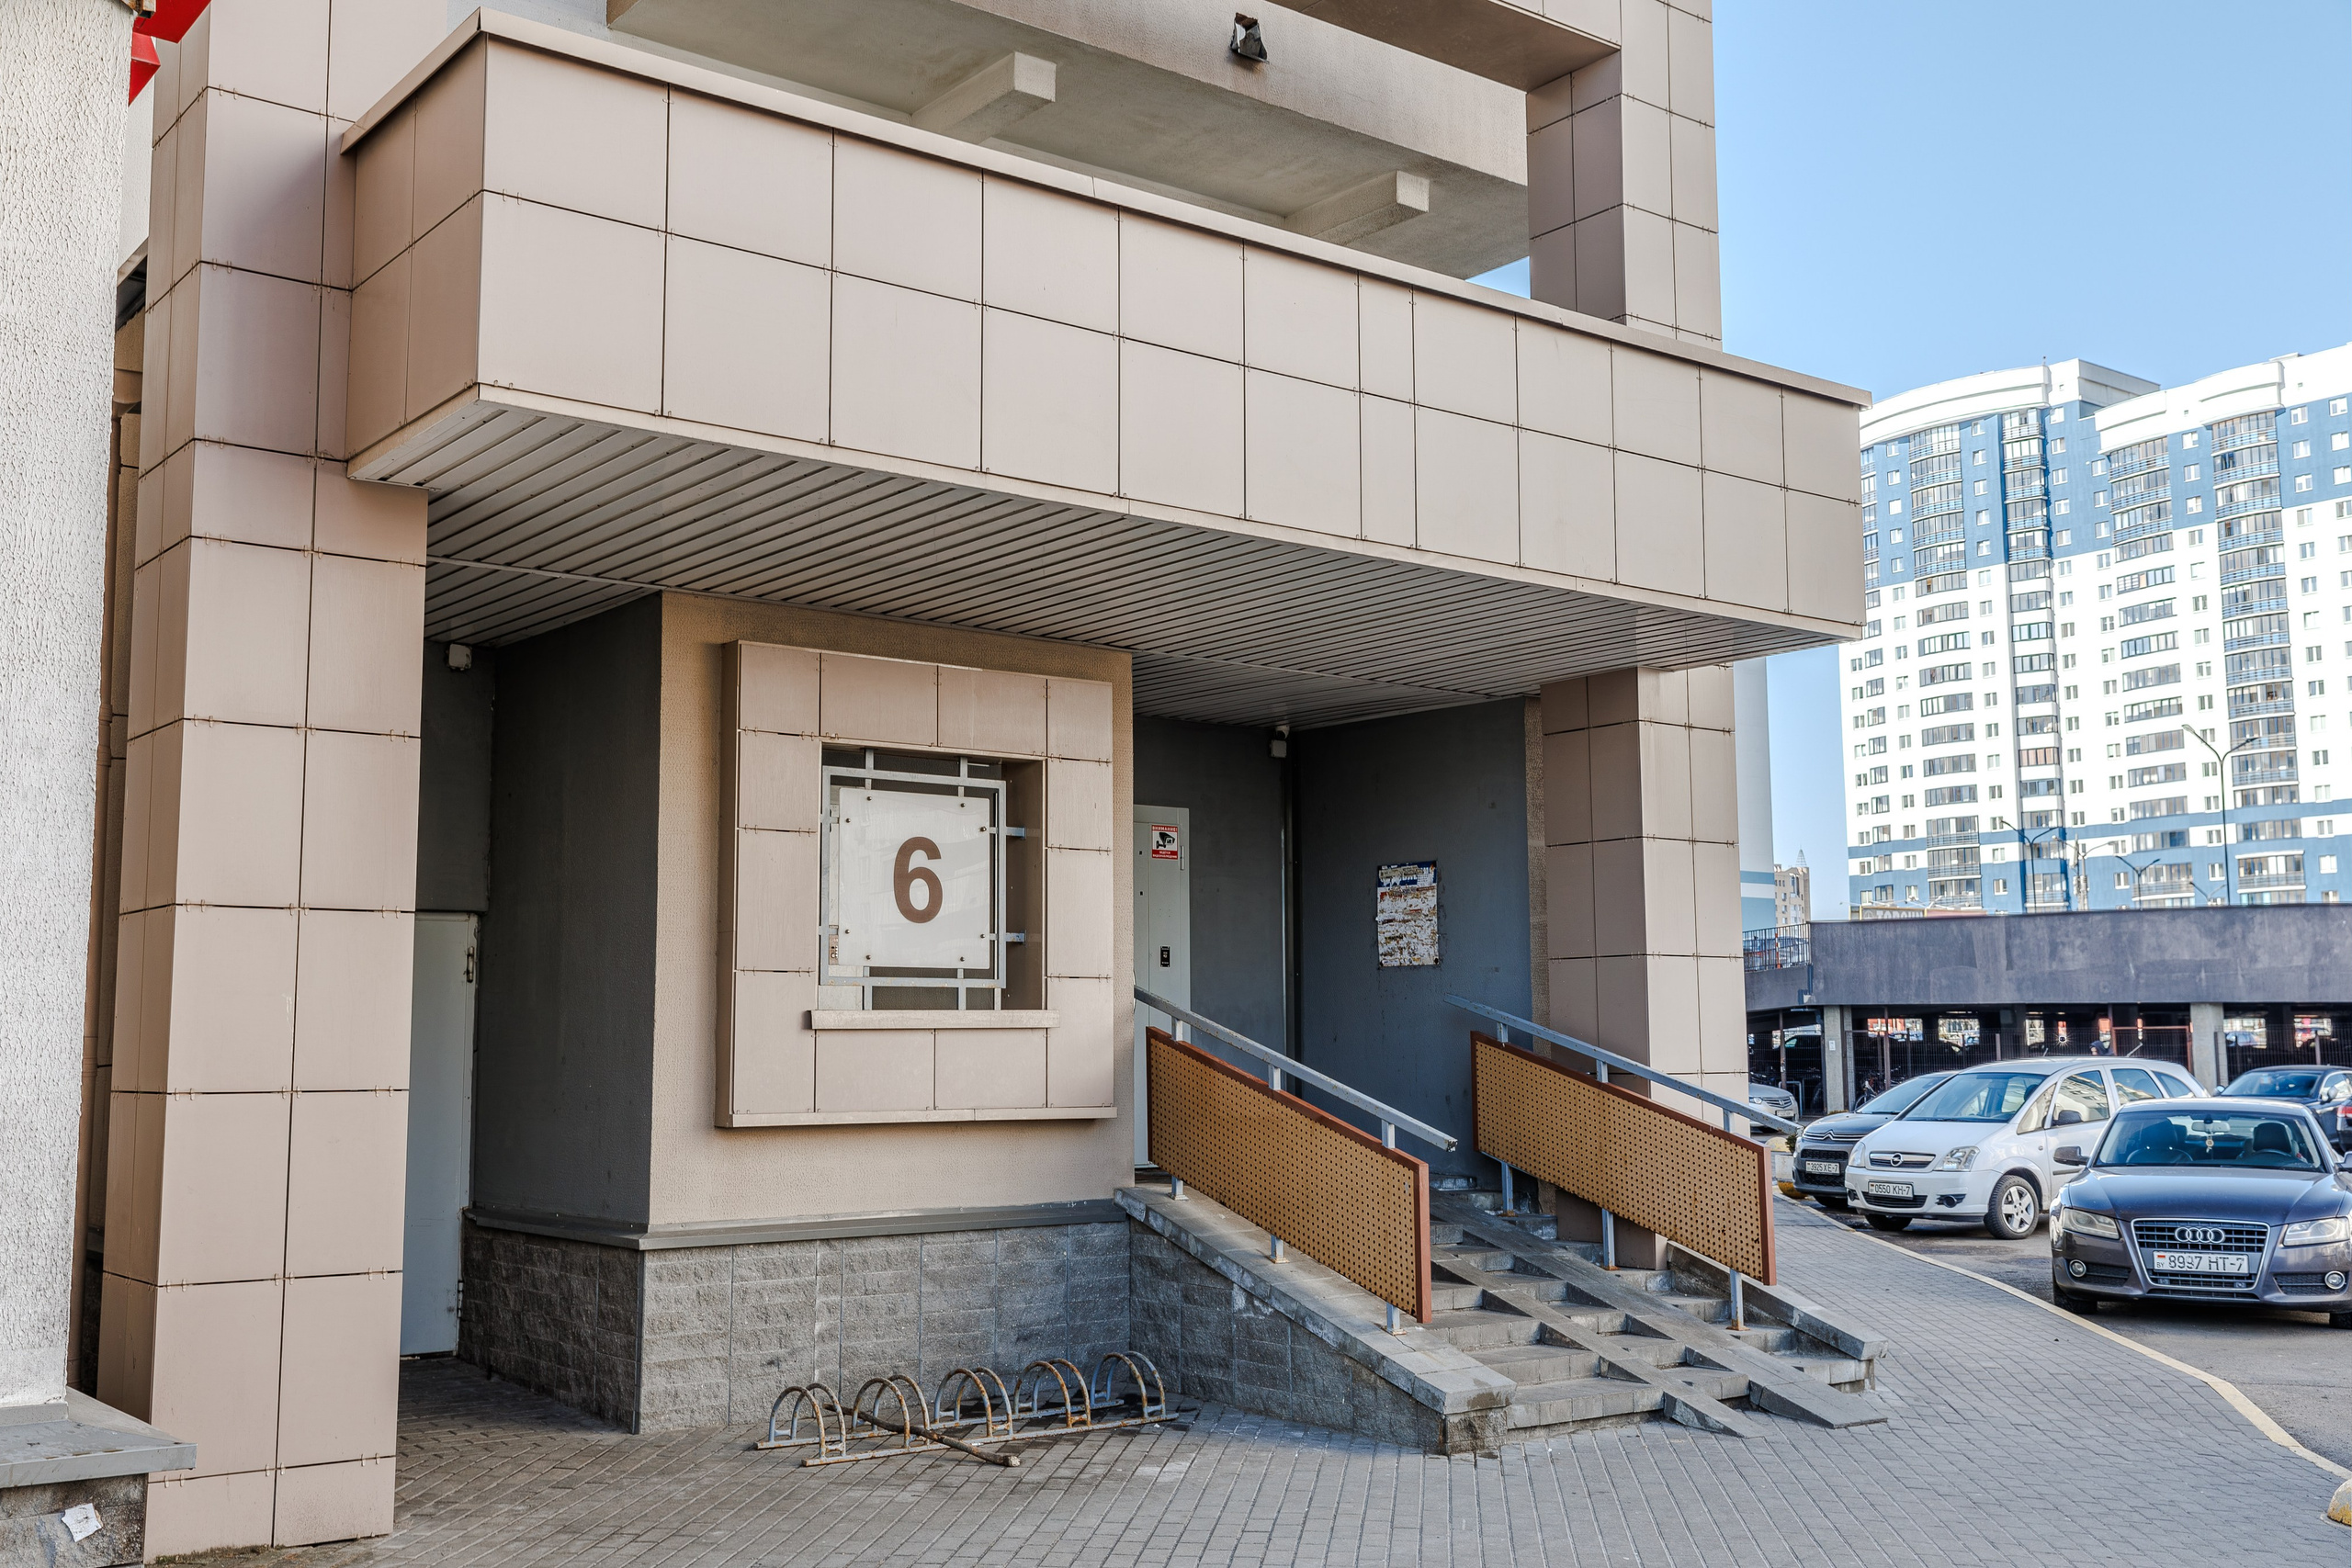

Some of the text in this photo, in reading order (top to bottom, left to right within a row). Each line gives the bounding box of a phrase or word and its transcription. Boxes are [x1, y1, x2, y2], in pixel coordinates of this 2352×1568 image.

[894, 836, 944, 924] 6
[1874, 1183, 1891, 1194] 0550
[1892, 1185, 1911, 1195] KH-7
[2208, 1256, 2245, 1271] HT-7
